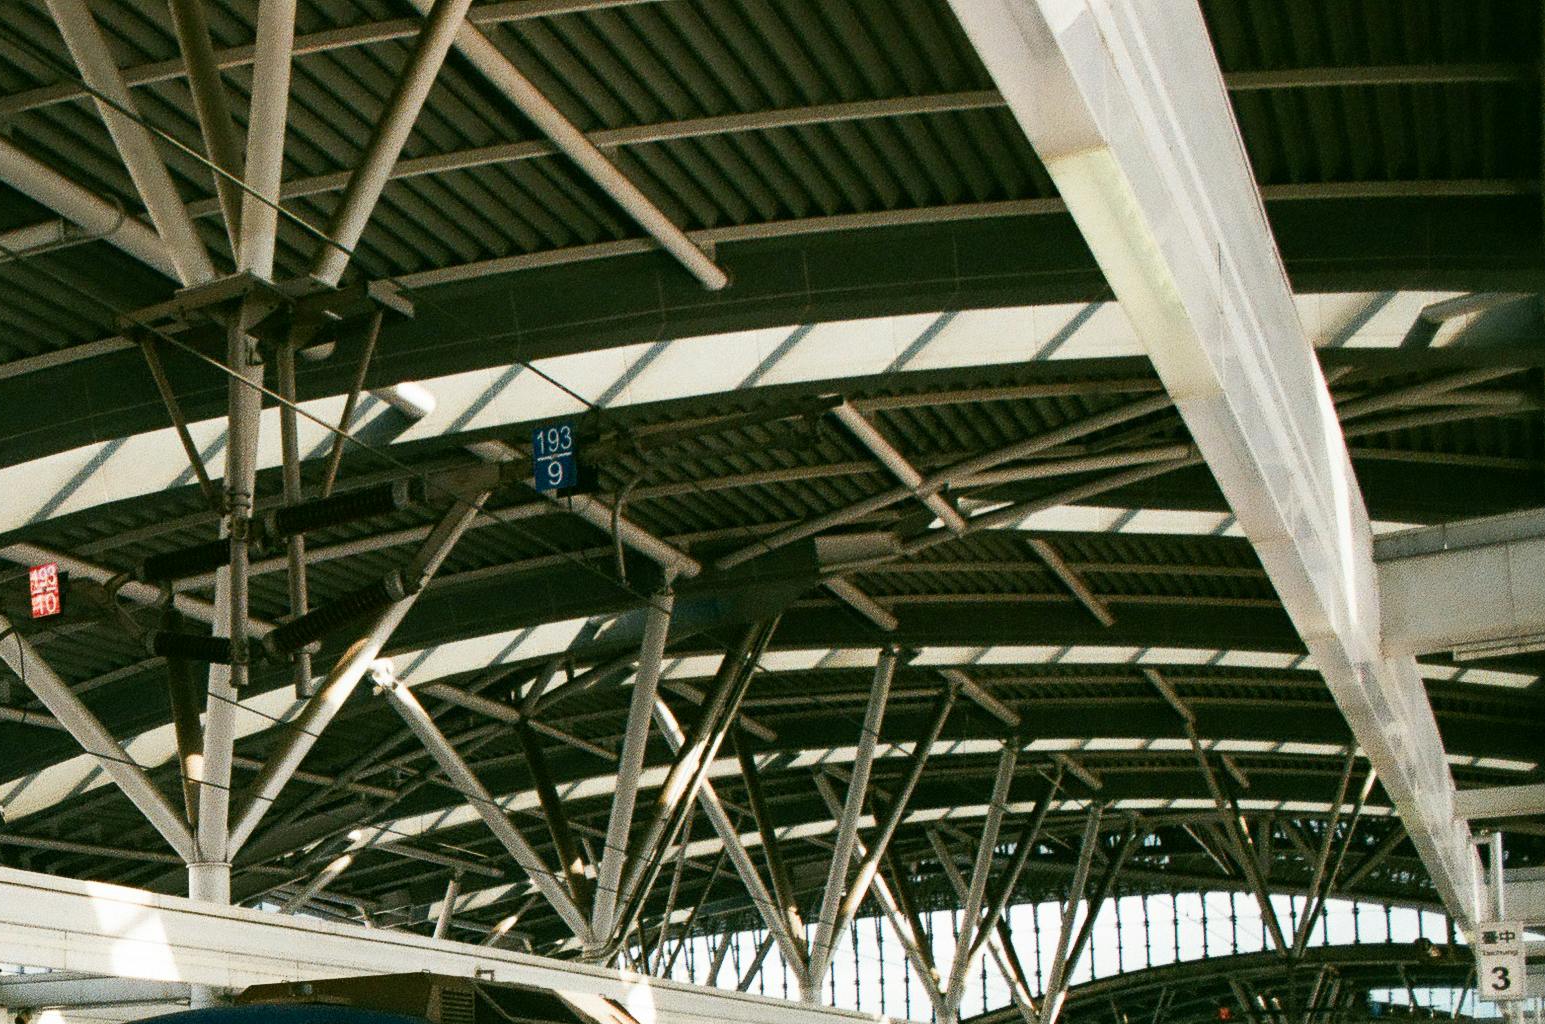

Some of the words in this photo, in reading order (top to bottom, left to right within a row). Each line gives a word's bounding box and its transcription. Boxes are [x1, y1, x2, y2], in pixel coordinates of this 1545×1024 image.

[537, 426, 572, 454] 193
[547, 461, 563, 486] 9
[1491, 966, 1511, 991] 3
